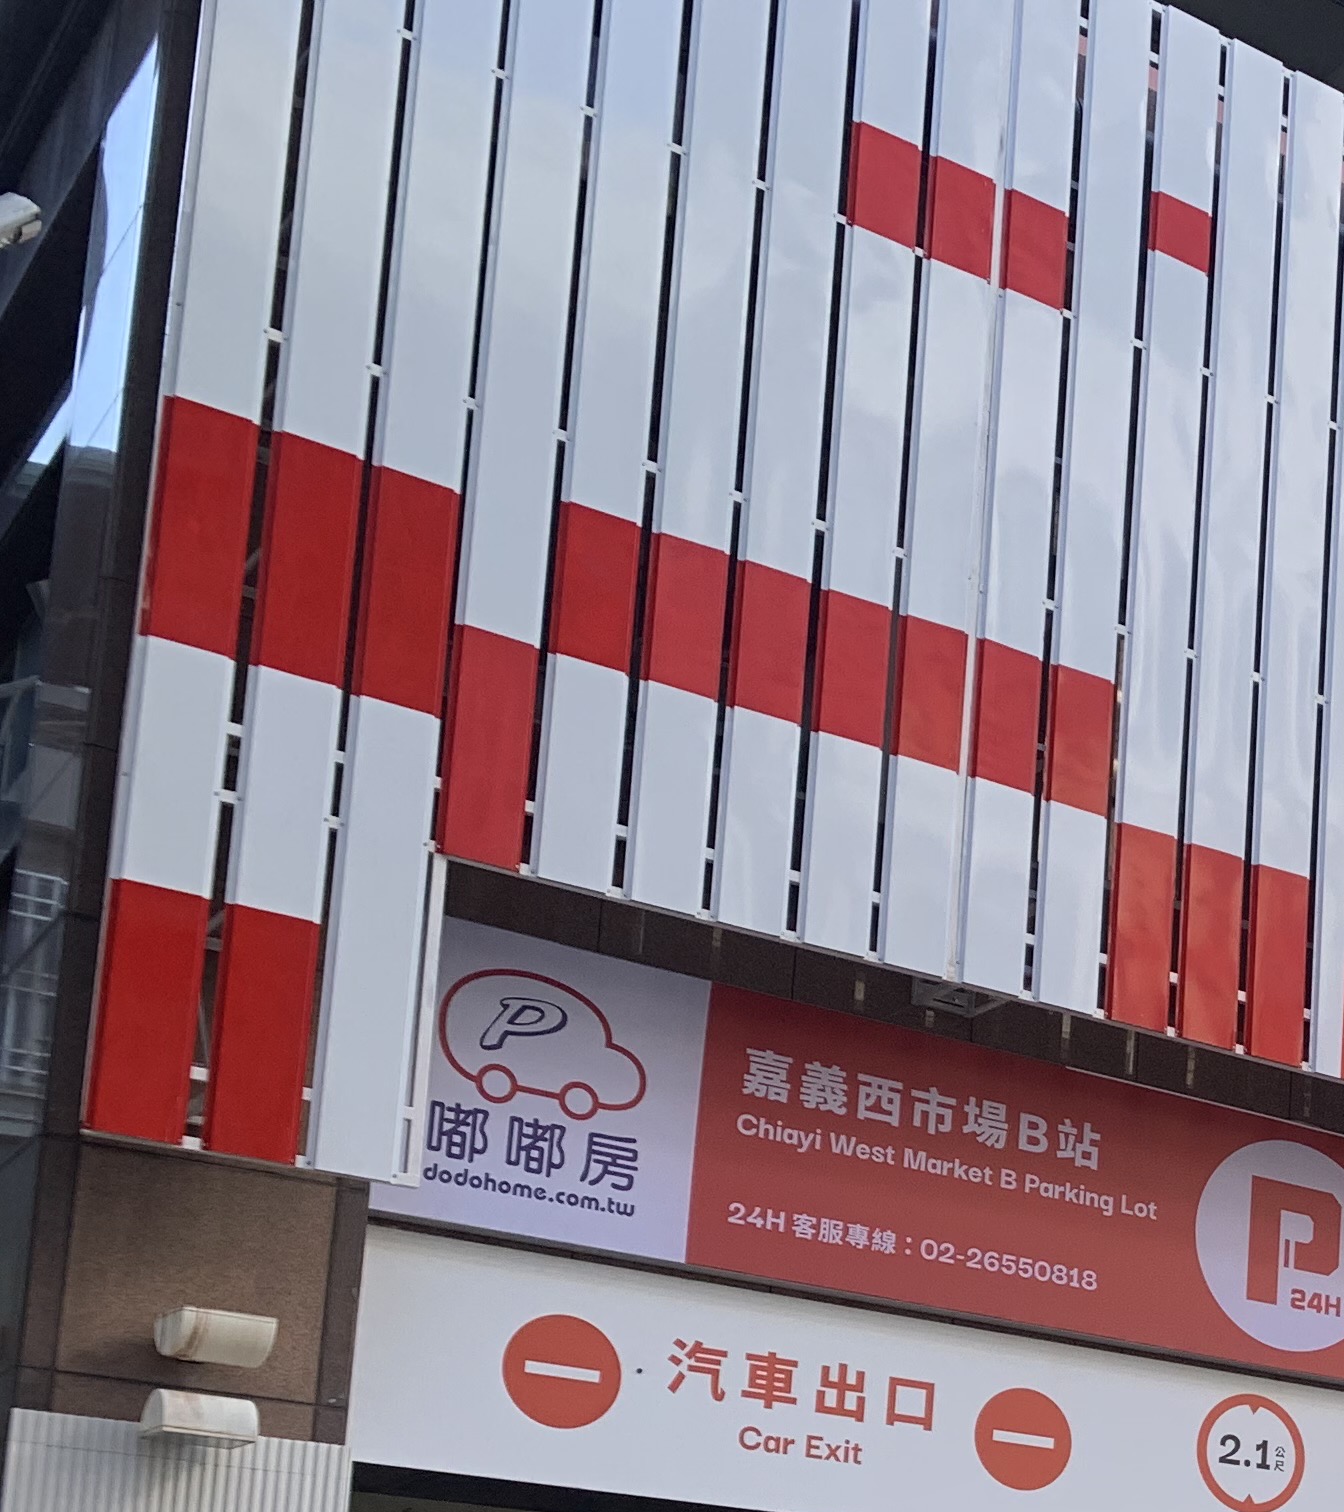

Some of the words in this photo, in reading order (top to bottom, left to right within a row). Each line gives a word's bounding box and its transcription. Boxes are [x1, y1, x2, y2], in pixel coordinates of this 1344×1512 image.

[426, 1100, 639, 1191] 嘟嘟房
[742, 1047, 1101, 1170] 嘉義西市場B站
[423, 1163, 635, 1217] dodohome.com.tw
[736, 1113, 822, 1153] Chiayi
[829, 1134, 896, 1166] West
[902, 1148, 993, 1186] Market
[1000, 1168, 1018, 1190] B
[1024, 1174, 1114, 1217] Parking
[1121, 1194, 1158, 1221] Lot
[727, 1202, 786, 1233] 24H
[919, 1238, 1098, 1291] 02-26550818
[1246, 1174, 1343, 1305] P
[1290, 1288, 1342, 1318] 24H
[668, 1338, 935, 1432] 汽車出口
[738, 1426, 795, 1455] Car
[805, 1434, 863, 1466] Exit
[1218, 1433, 1271, 1471] 2.1
[1274, 1446, 1286, 1473] 公尺
